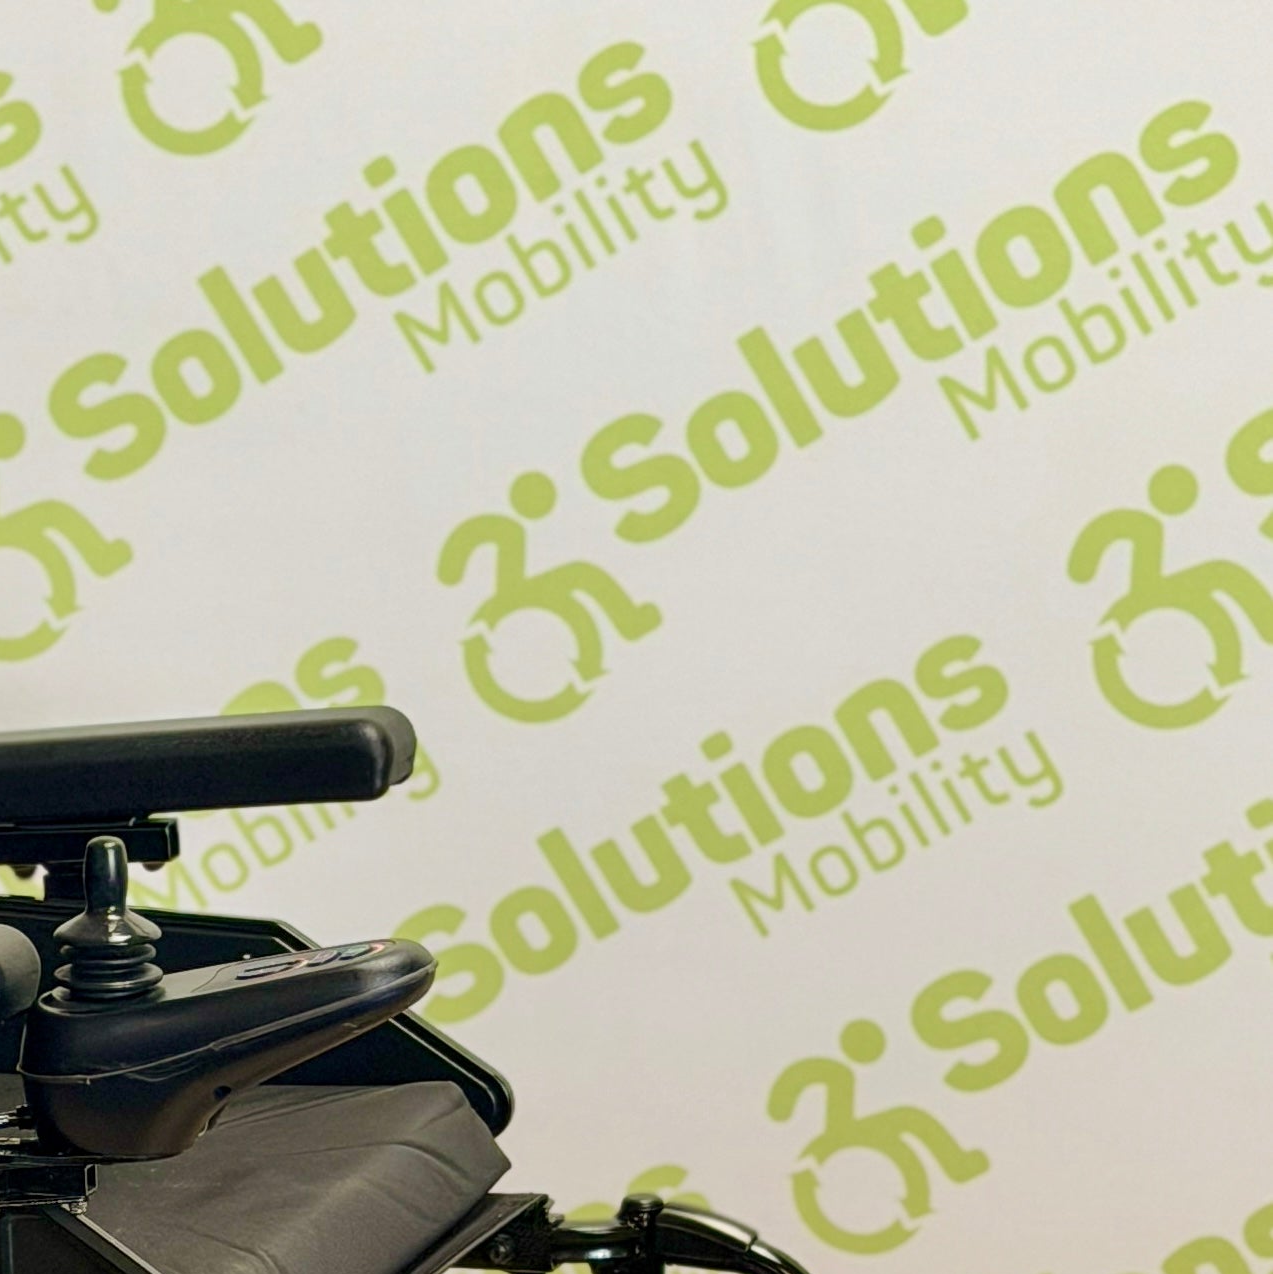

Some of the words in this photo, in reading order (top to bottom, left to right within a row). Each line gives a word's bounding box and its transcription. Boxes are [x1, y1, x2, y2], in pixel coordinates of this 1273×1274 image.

[48, 41, 673, 482] Solutions
[393, 141, 729, 373] Mobility
[580, 100, 1240, 544] Solutions
[387, 634, 1010, 1031] Solutions
[729, 731, 1064, 937] Mobility
